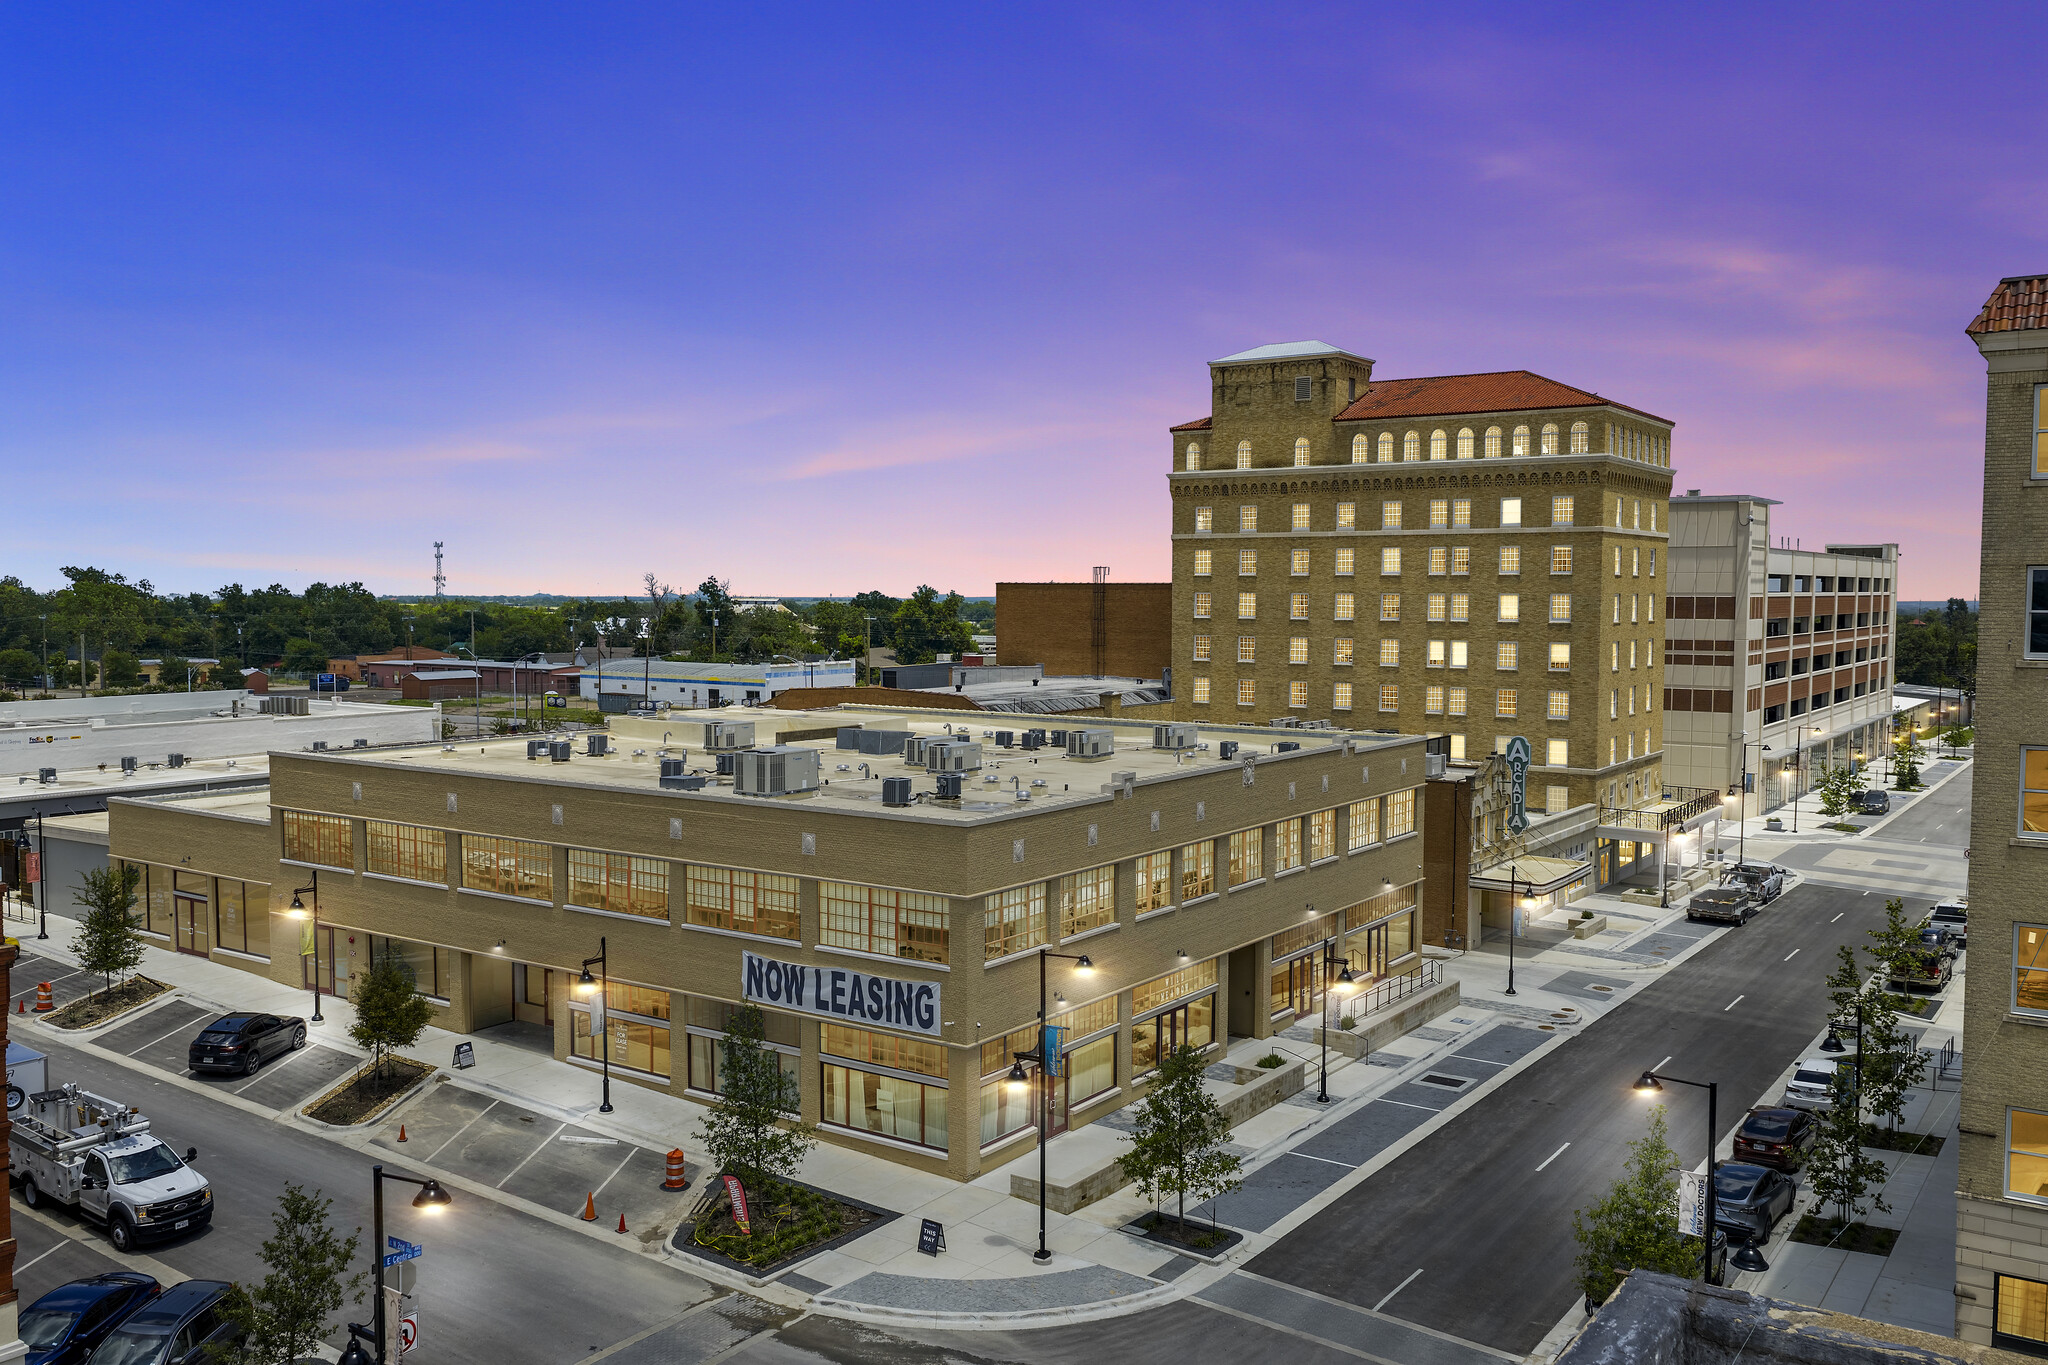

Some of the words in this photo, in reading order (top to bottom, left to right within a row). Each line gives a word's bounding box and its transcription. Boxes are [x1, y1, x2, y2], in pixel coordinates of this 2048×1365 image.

[1508, 740, 1529, 828] ARCADIA
[1165, 972, 1184, 987] WILD
[747, 955, 806, 1007] NOW
[815, 968, 935, 1030] LEASING
[1160, 982, 1189, 1002] MEADOW
[615, 1037, 628, 1046] LEASE
[1697, 1179, 1705, 1217] DOCTORS
[923, 1227, 937, 1237] THIS
[923, 1234, 935, 1243] WAY
[386, 1257, 391, 1266] E
[392, 1253, 413, 1264] Central
